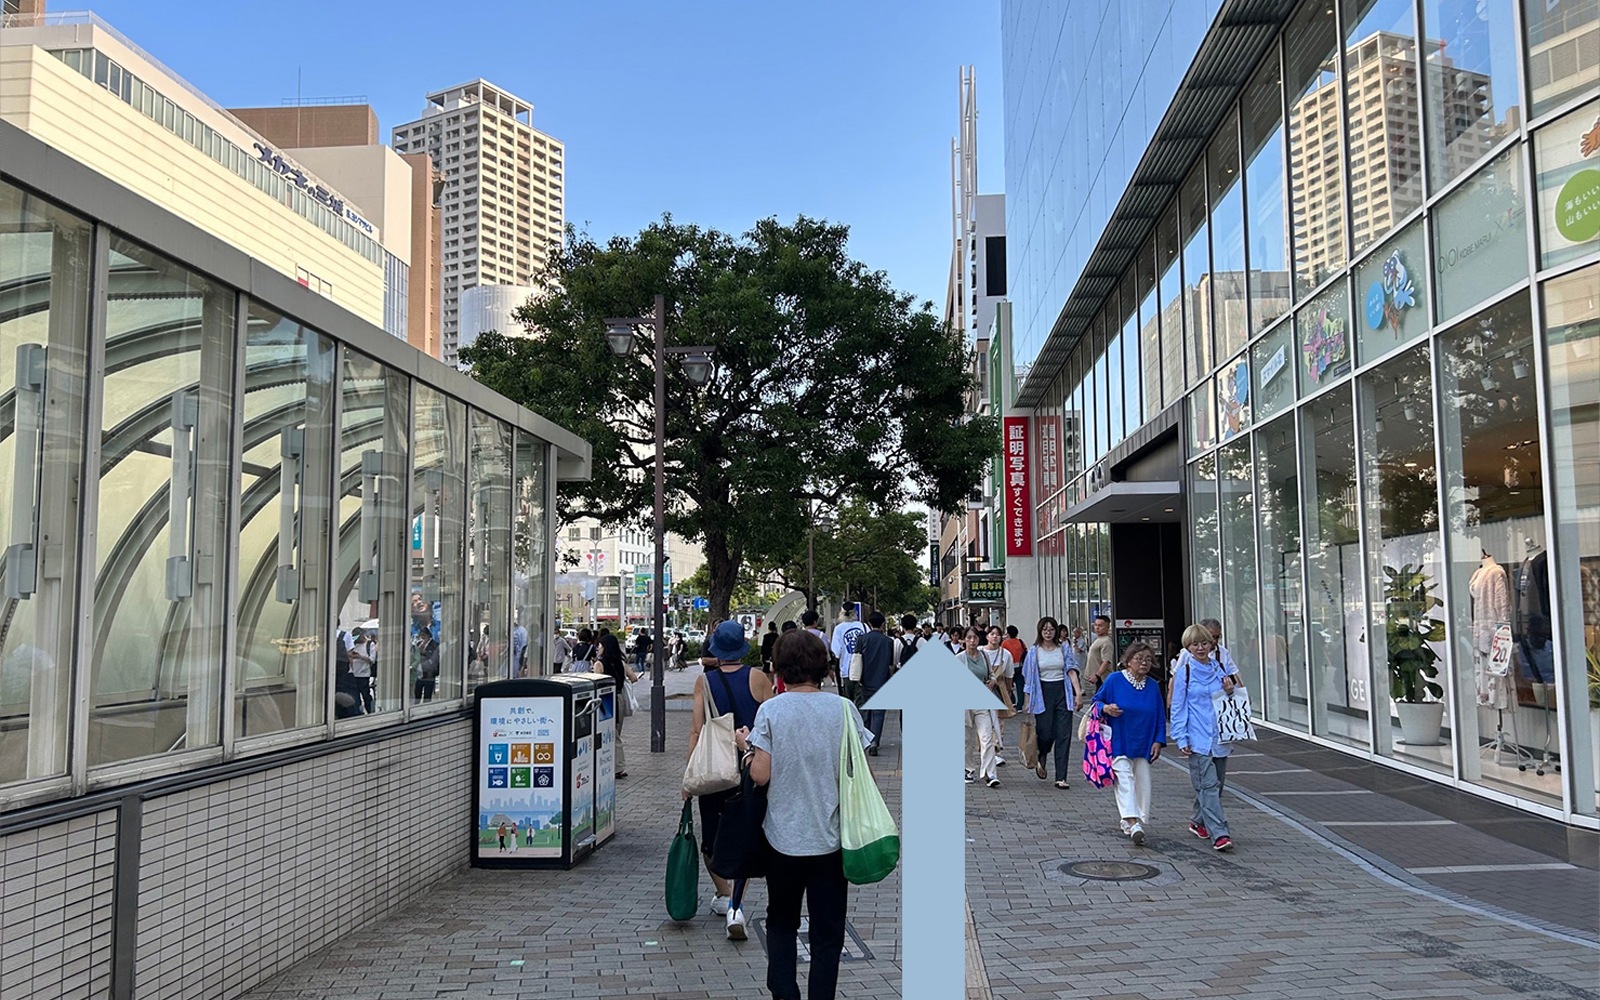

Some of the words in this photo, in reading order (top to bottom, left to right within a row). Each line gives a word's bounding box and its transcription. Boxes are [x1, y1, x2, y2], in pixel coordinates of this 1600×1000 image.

[1008, 425, 1026, 548] 証明写真すぐできます
[971, 582, 1002, 590] 証明写真
[490, 716, 554, 725] 環境にやさしい街へ
